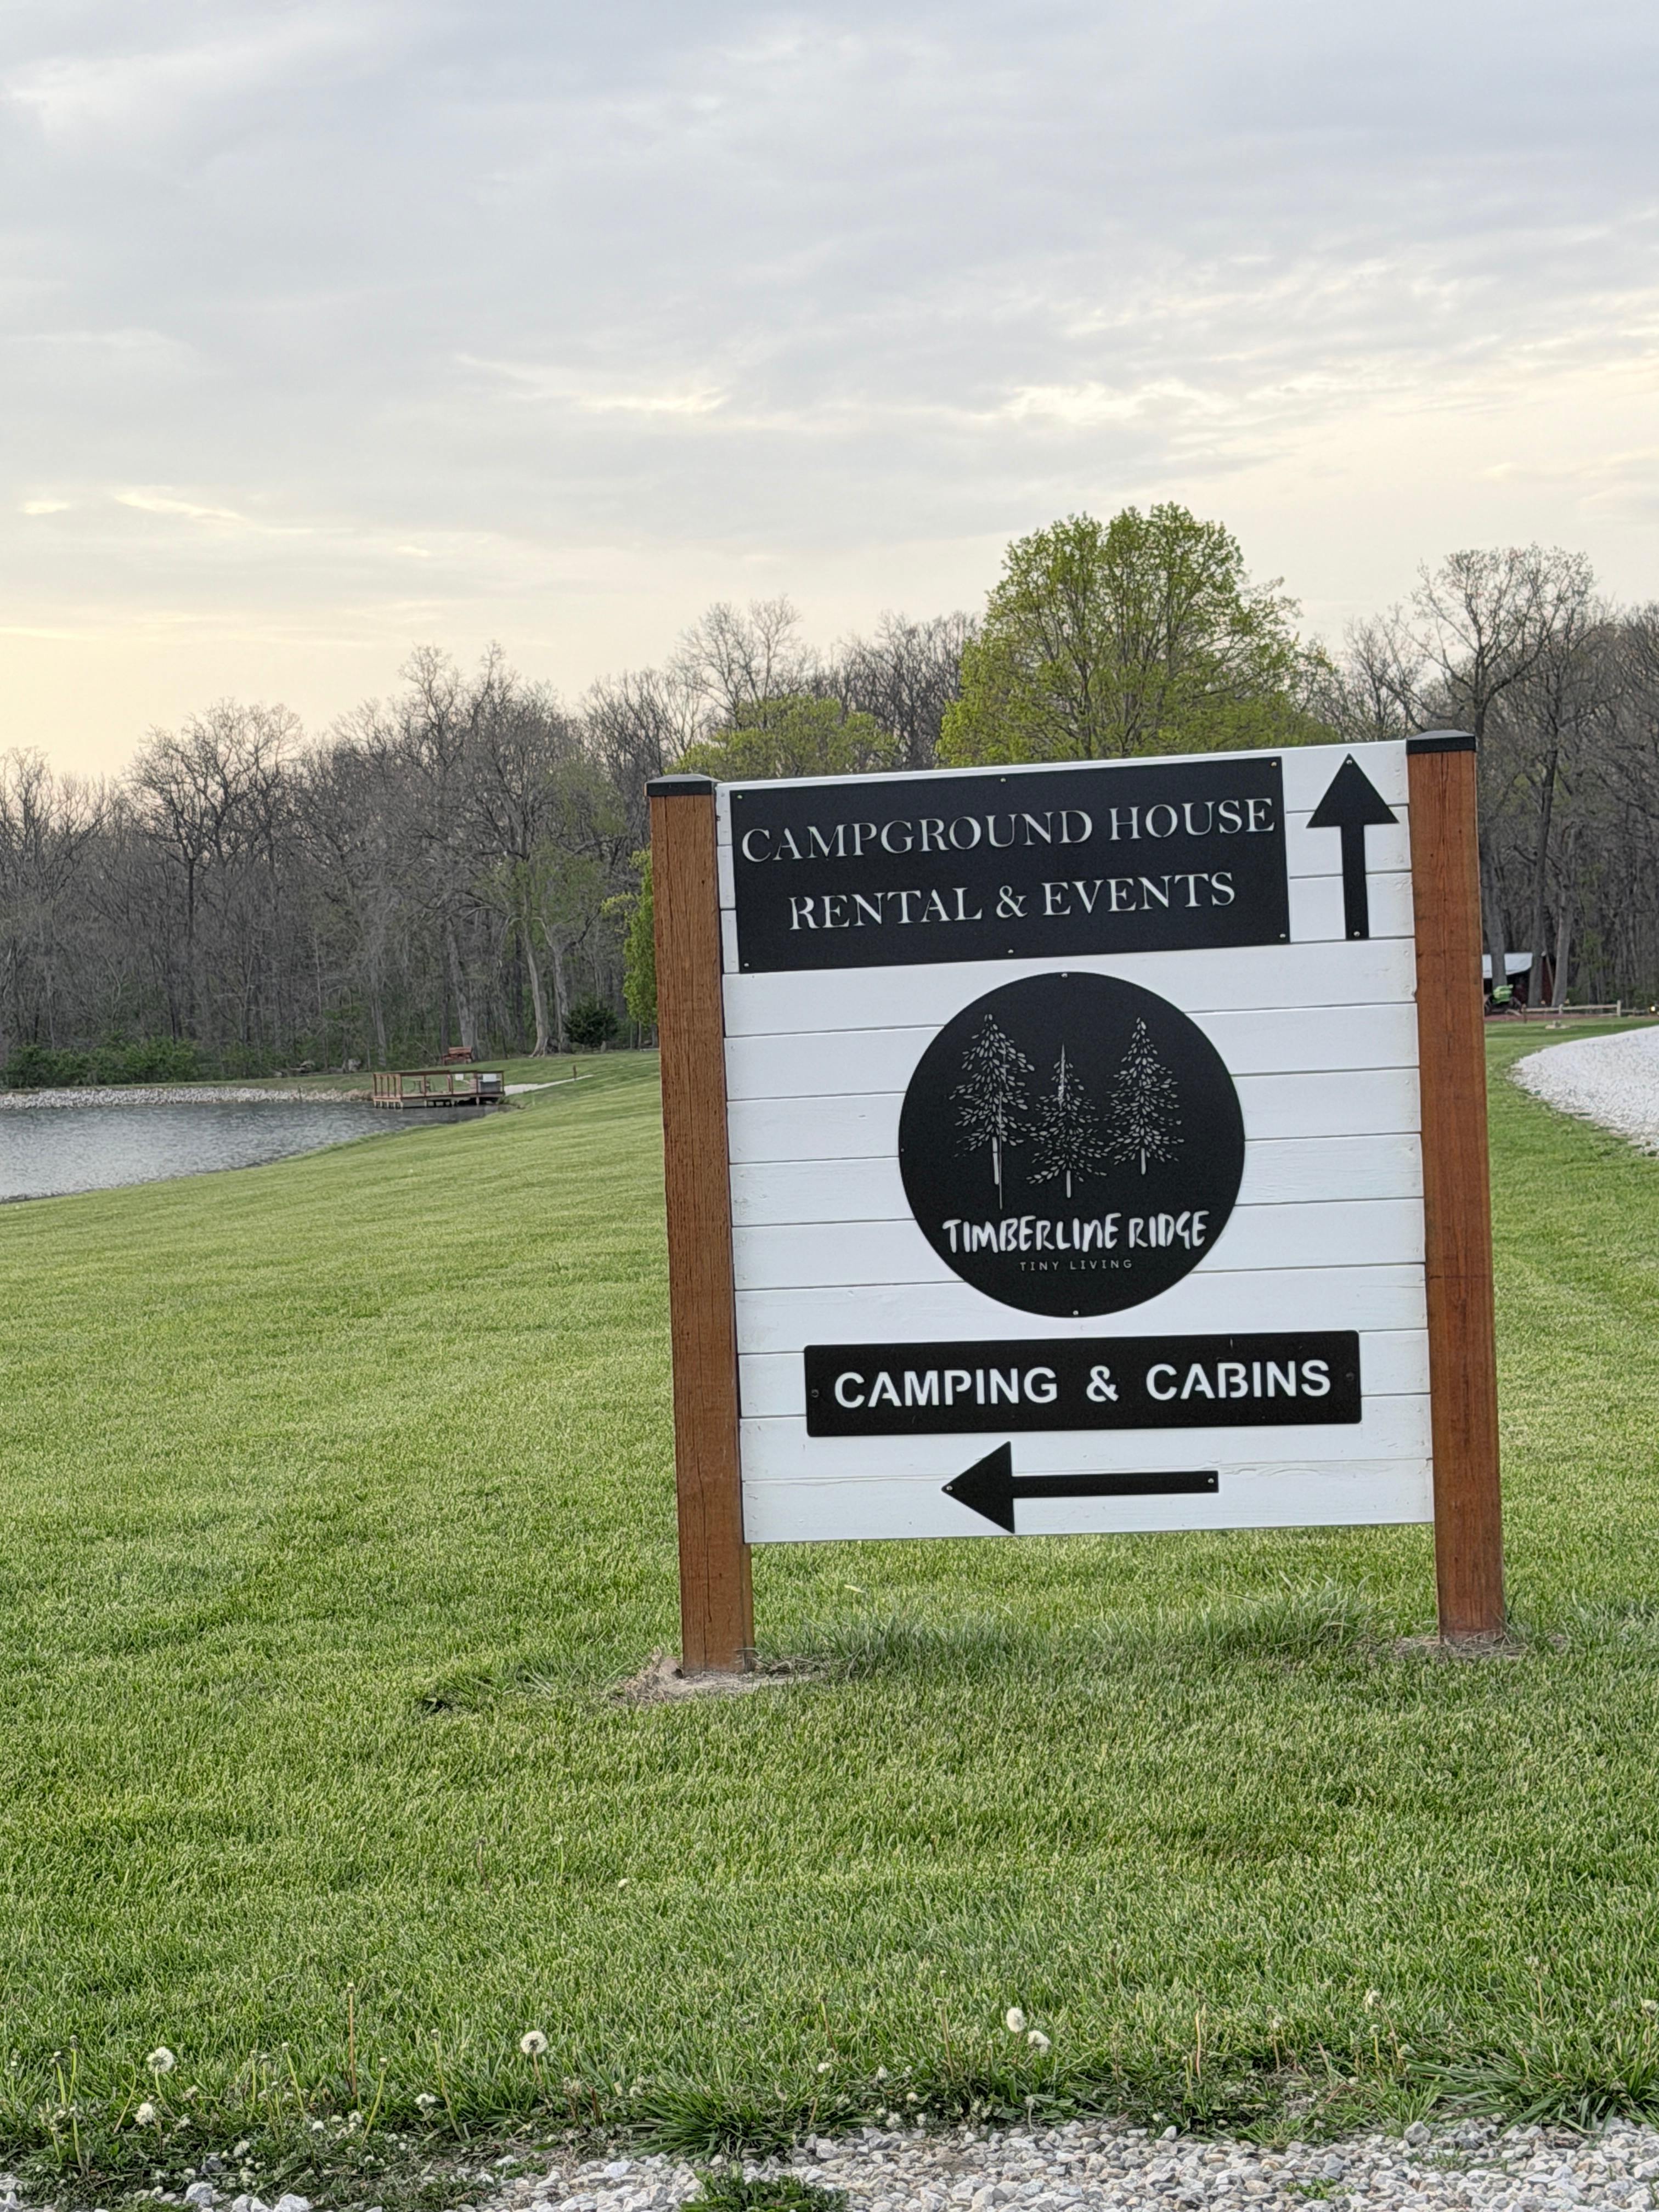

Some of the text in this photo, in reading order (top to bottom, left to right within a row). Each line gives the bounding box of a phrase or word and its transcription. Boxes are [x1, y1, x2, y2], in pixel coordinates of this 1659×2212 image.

[742, 798, 1275, 862] CAMPGROUND HOUSE
[789, 872, 1235, 930] RENTAL & EVENTS
[942, 1210, 1210, 1253] TIMBERLINE RIDGE
[1020, 1259, 1132, 1271] TINY LIVING
[834, 1359, 1331, 1408] CAMPING & CABINS
